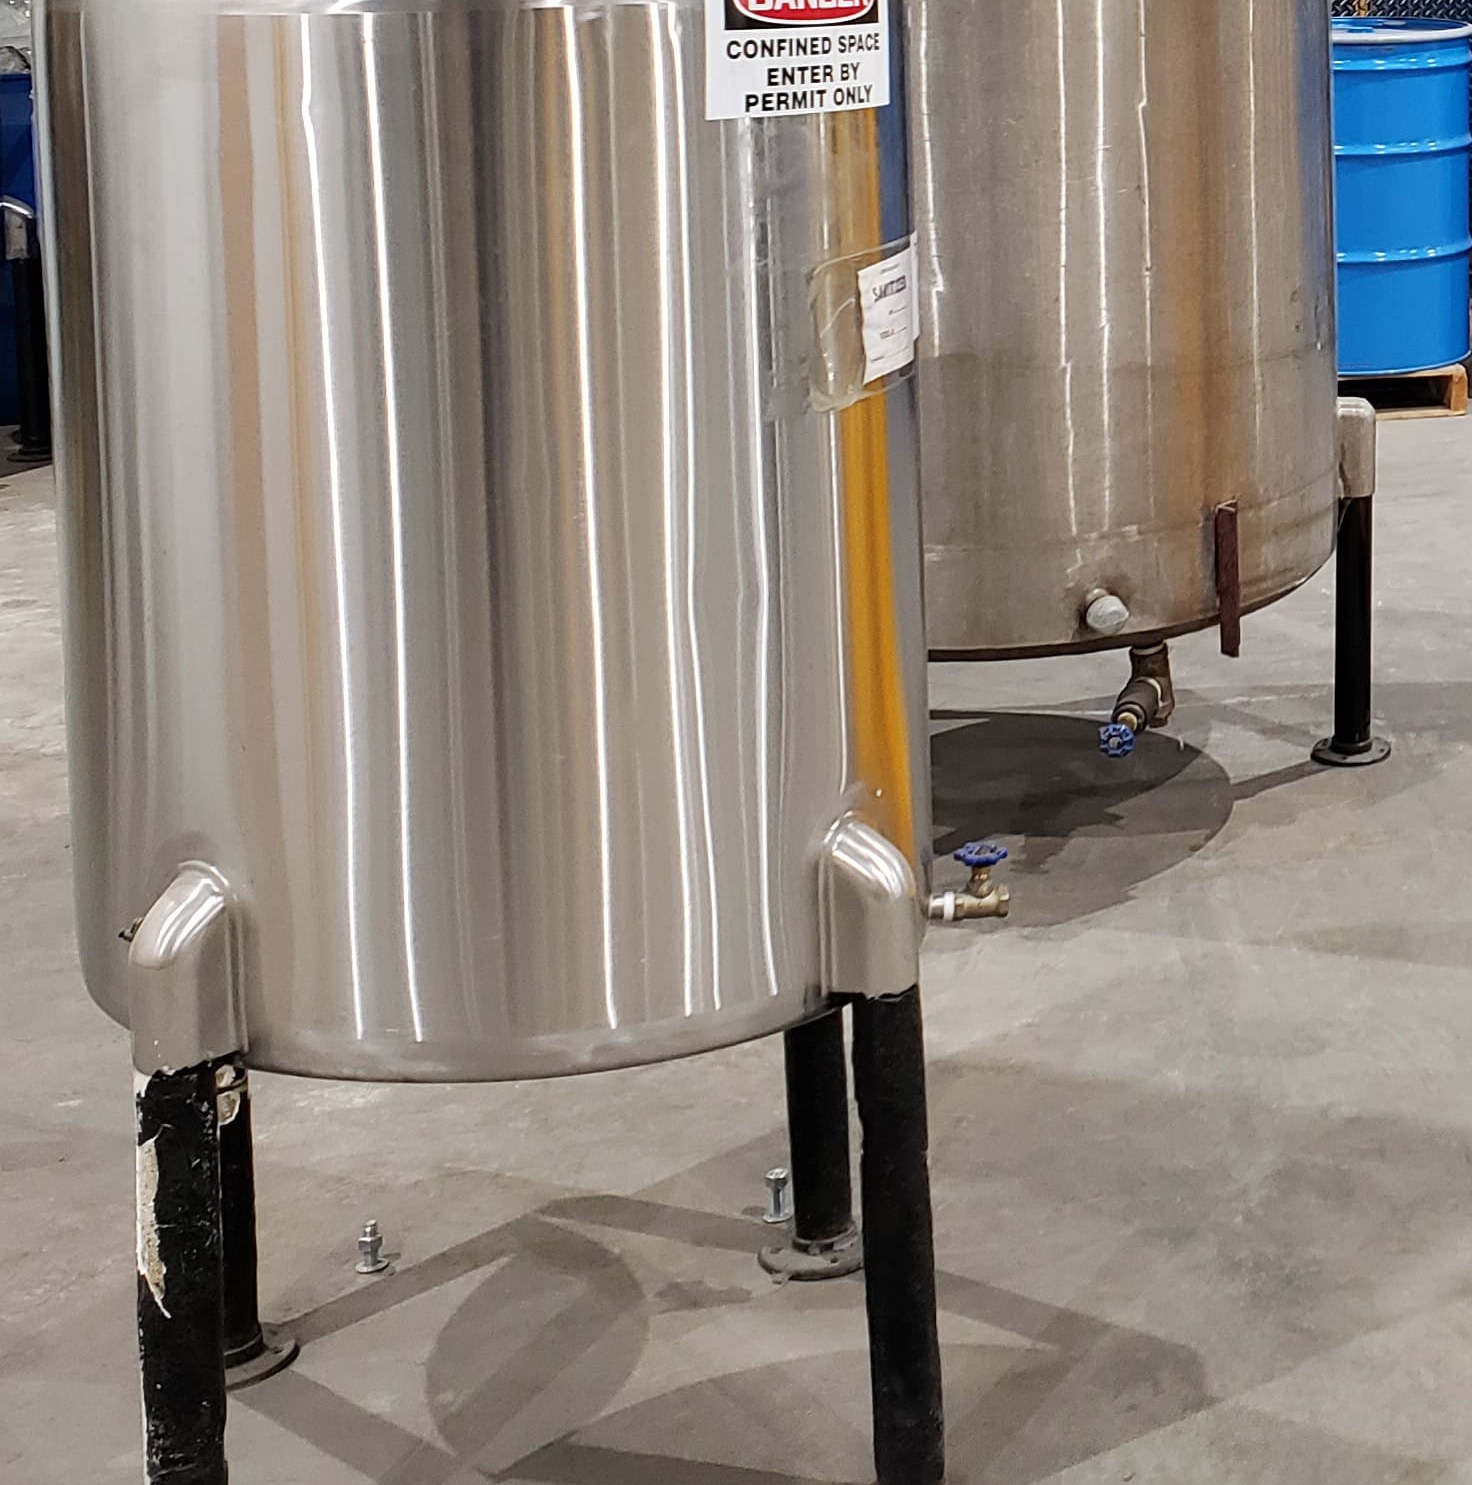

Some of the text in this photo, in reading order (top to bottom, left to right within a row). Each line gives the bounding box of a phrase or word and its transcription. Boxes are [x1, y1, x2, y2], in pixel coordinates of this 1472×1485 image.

[727, 32, 880, 60] CONFINED SPACE
[767, 62, 861, 87] ENTER BY
[745, 84, 873, 113] PERMIT ONLY
